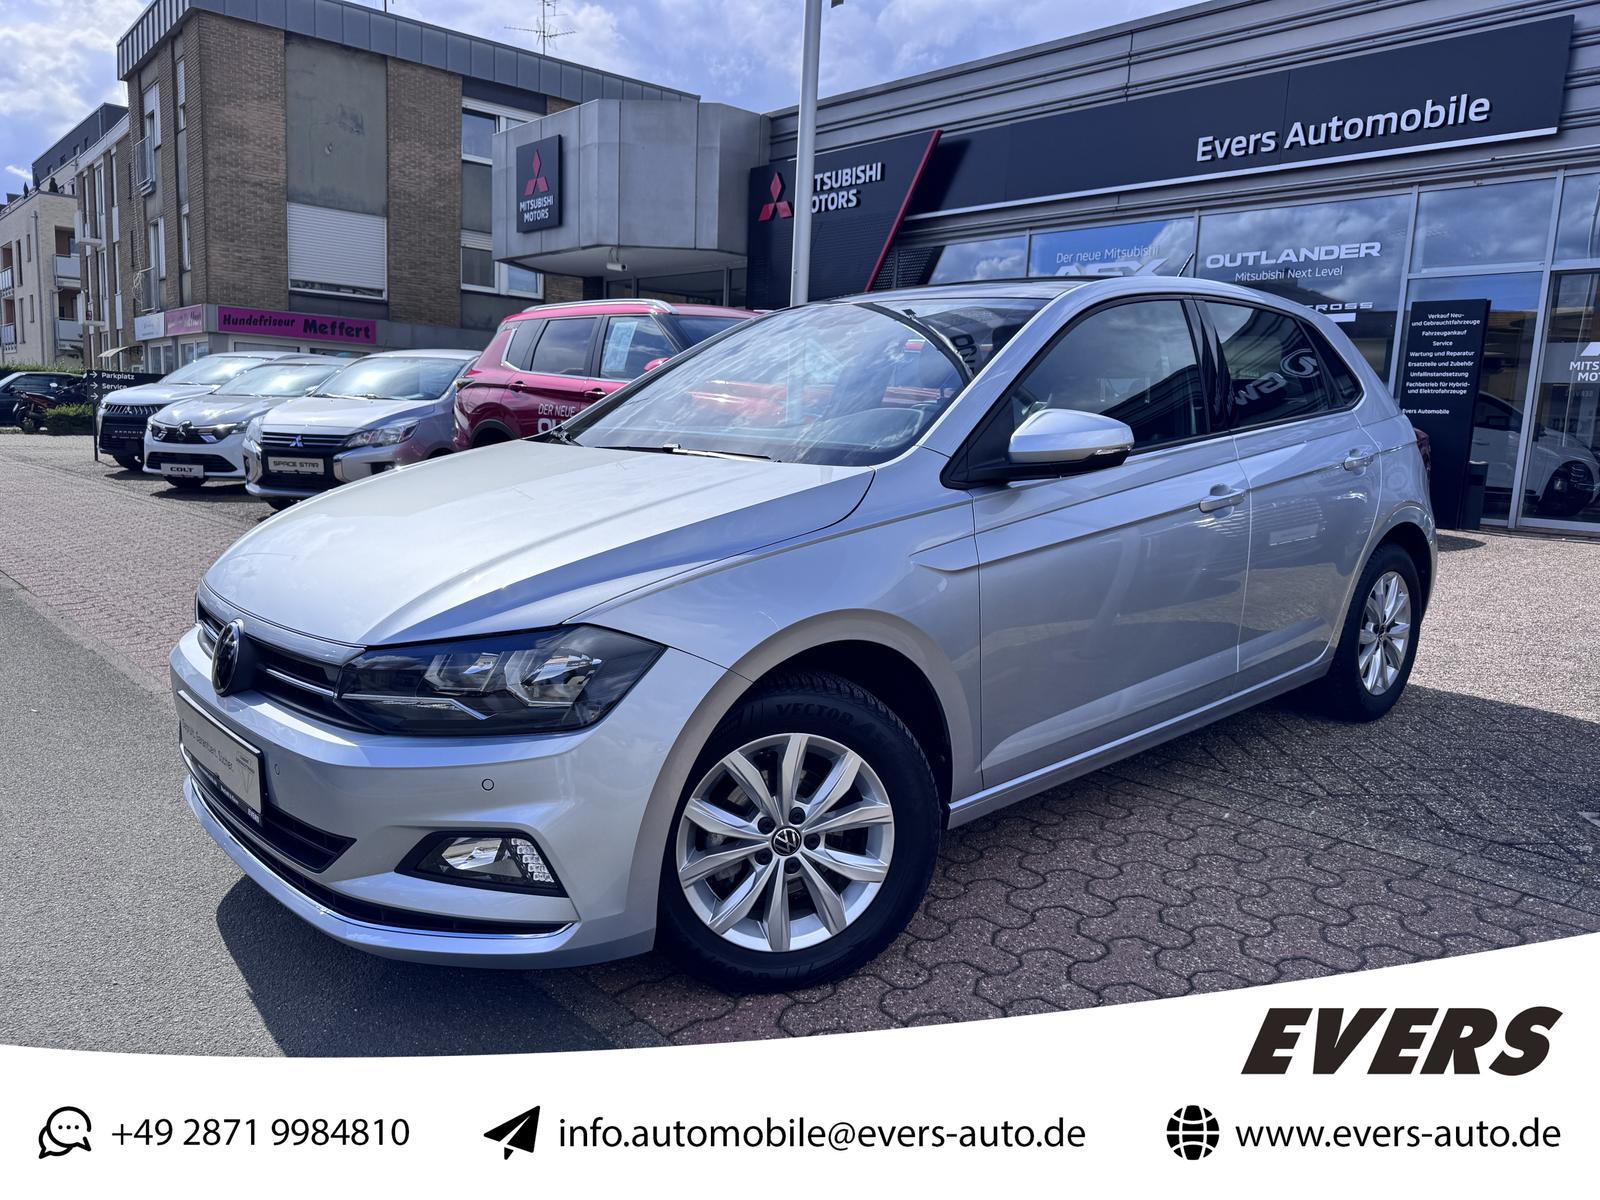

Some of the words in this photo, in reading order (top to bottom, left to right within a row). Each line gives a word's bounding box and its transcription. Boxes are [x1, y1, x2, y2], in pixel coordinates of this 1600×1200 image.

[1197, 128, 1276, 162] Evers
[1284, 93, 1491, 149] Automobile
[814, 162, 882, 192] TSUBISHI
[519, 195, 554, 212] MITSUBISHI
[811, 189, 858, 213] OTORS
[523, 208, 549, 223] MOTORS
[1056, 252, 1073, 263] Der
[1076, 250, 1101, 261] neue
[1104, 245, 1159, 259] Mitsubishi
[1206, 241, 1382, 269] OUTLANDER
[1235, 268, 1286, 283] Mitsubishi
[1287, 266, 1312, 279] Next
[1315, 265, 1344, 277] Level
[223, 314, 295, 327] Hundefriseur
[303, 319, 370, 339] Meffert
[101, 372, 135, 380] Parkplatz
[538, 403, 554, 416] DER
[555, 405, 576, 417] NEUE
[272, 460, 297, 468] SPACE
[299, 460, 319, 468] STAR
[776, 703, 854, 722] VECTOR
